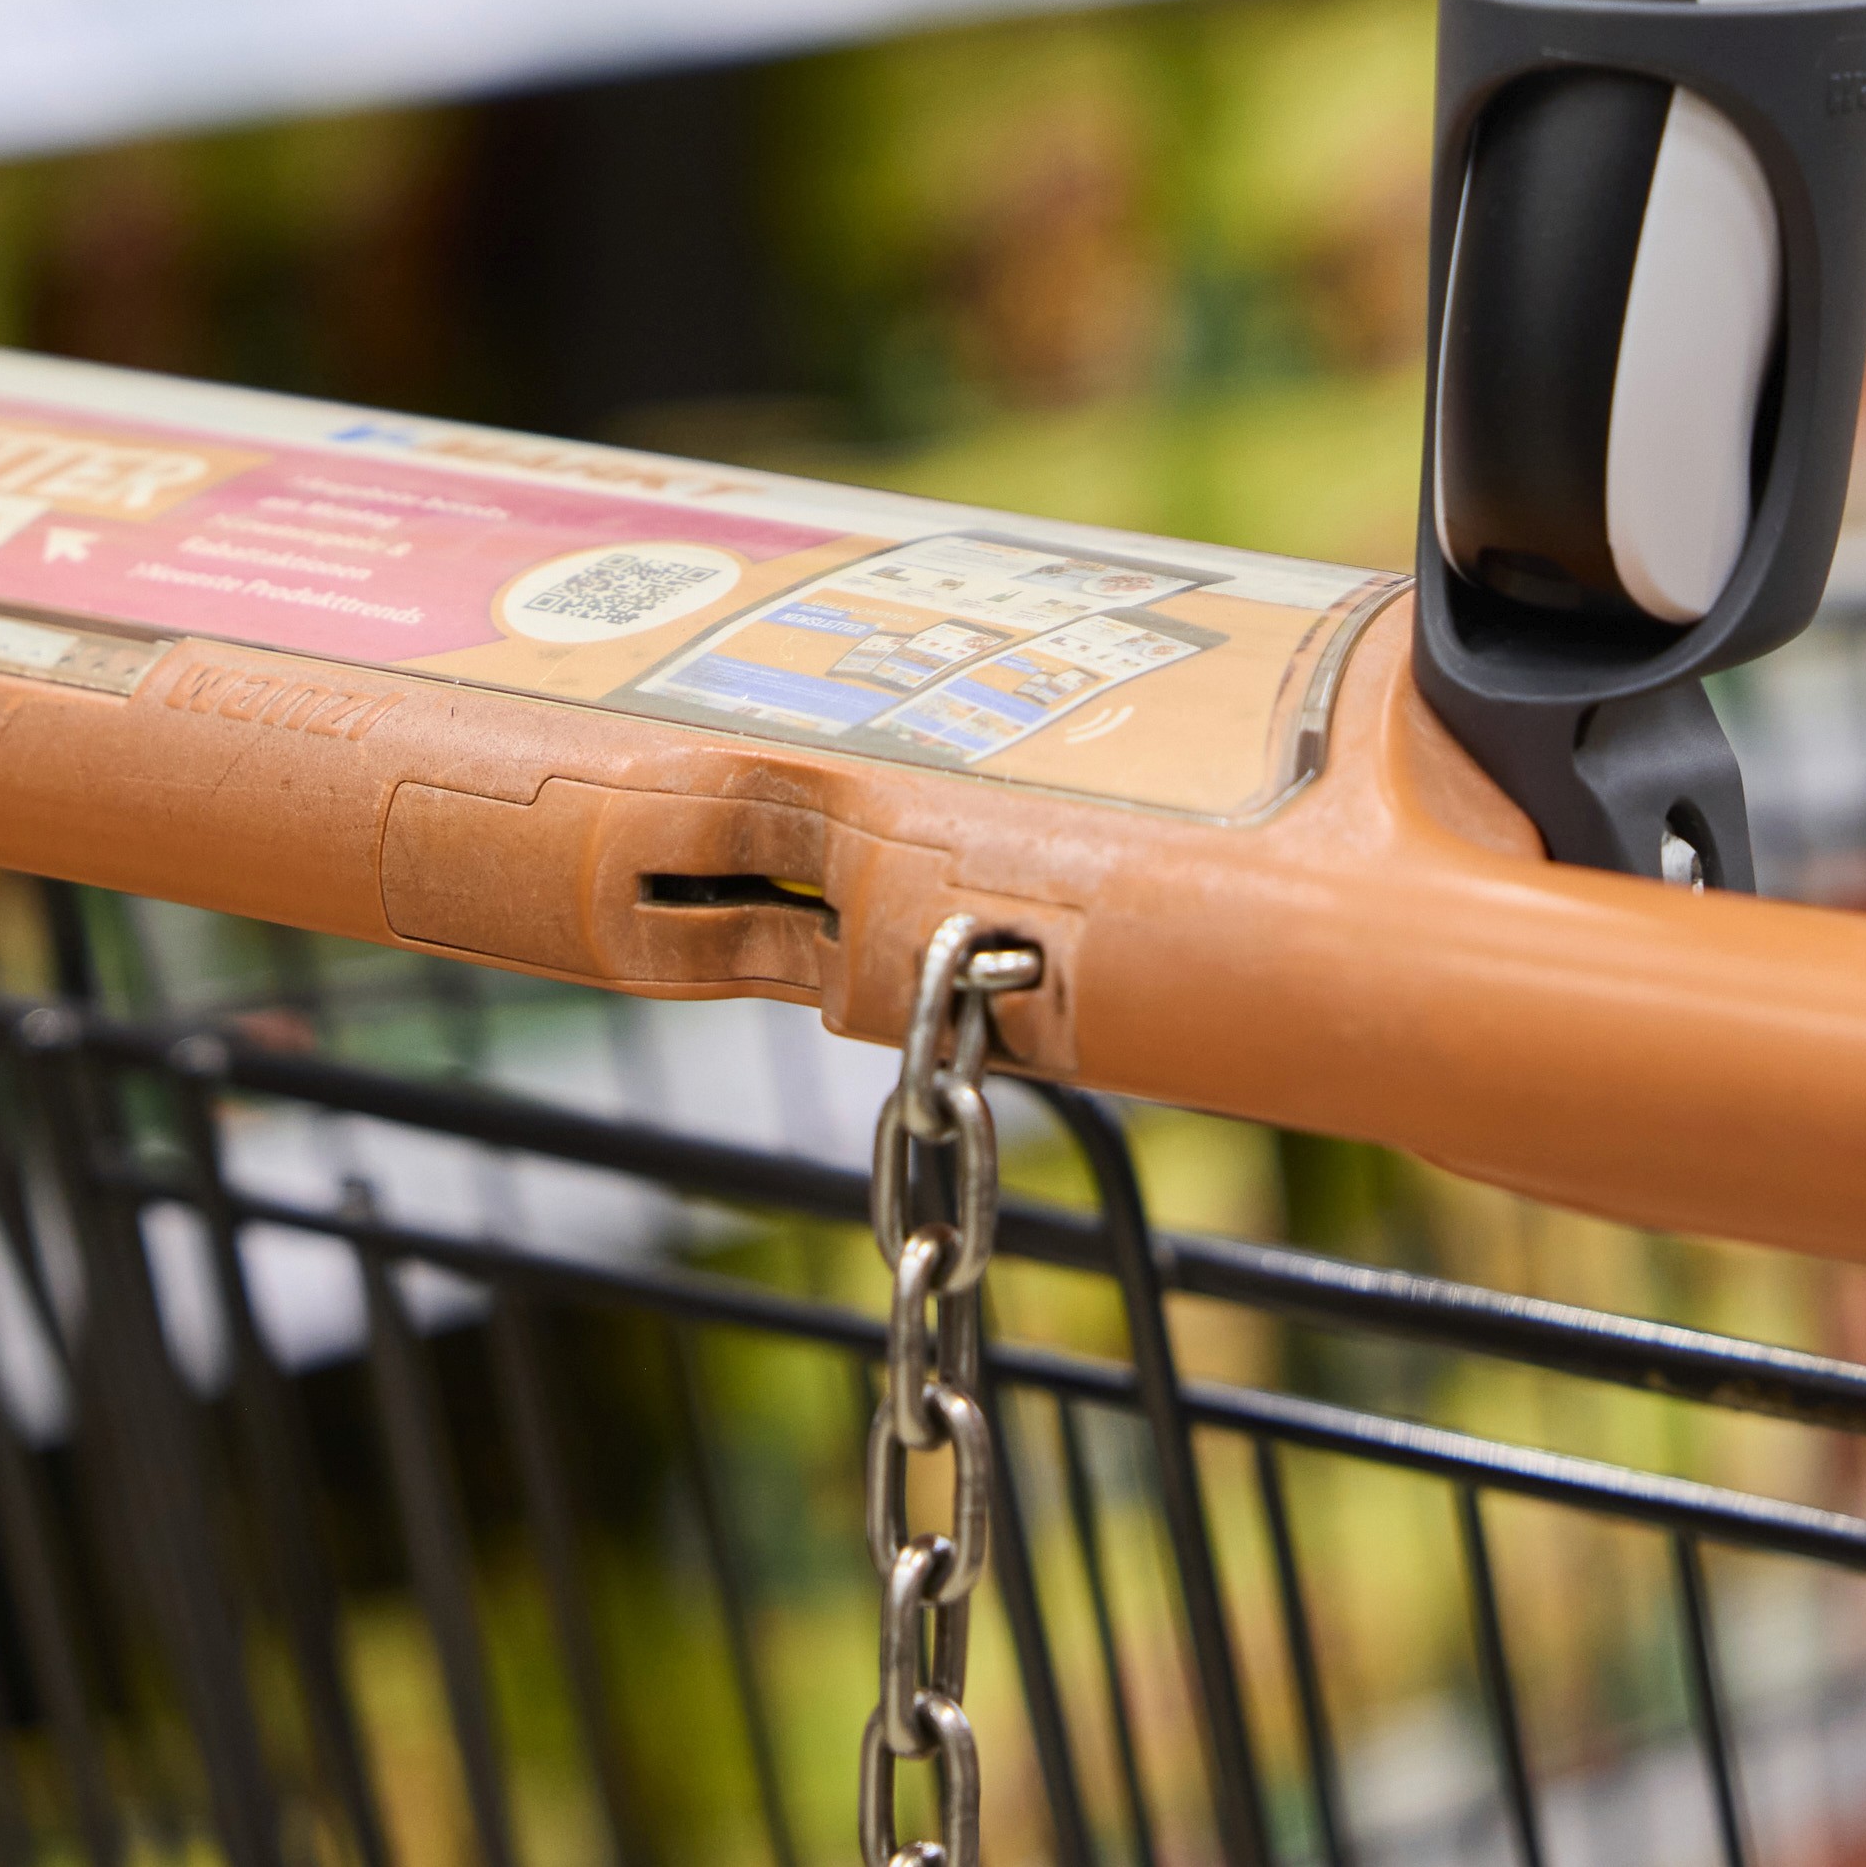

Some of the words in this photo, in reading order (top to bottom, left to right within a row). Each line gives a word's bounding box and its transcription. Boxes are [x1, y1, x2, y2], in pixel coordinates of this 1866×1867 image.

[241, 578, 426, 626] Produkttrends
[778, 612, 868, 635] NEWSLETTER
[164, 661, 409, 742] wanzl
